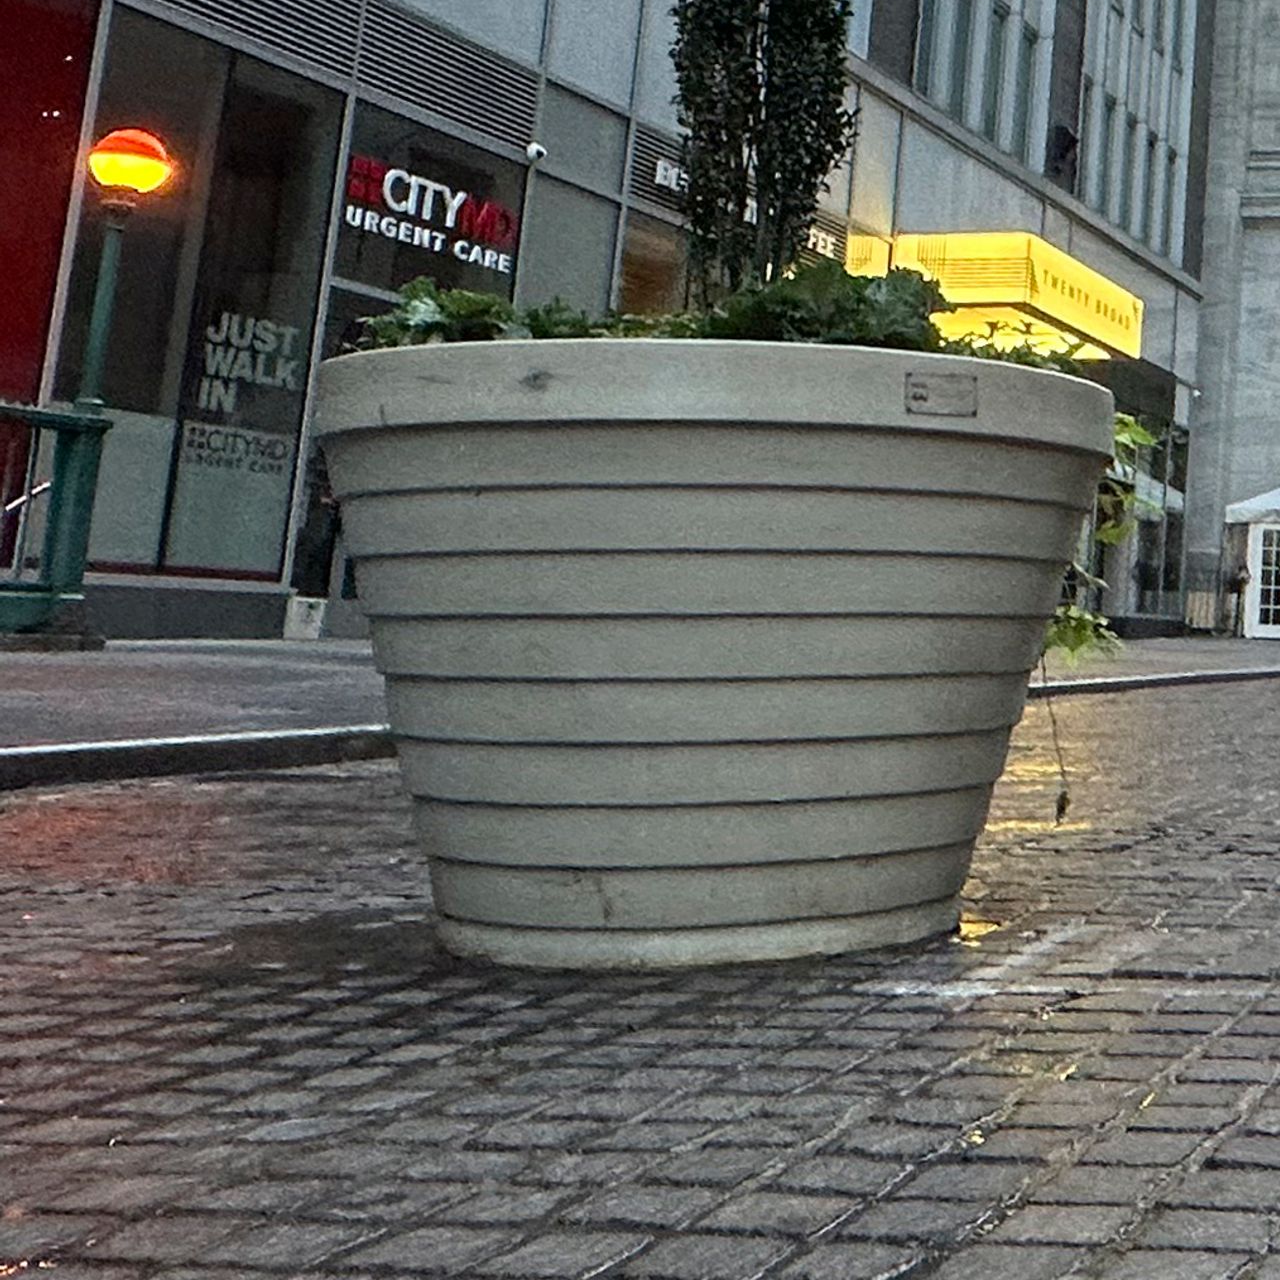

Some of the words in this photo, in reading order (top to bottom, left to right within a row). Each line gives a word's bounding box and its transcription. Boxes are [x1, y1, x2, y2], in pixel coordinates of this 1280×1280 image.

[382, 168, 515, 247] CITYMD
[346, 205, 446, 252] URGENT
[453, 240, 513, 274] CARE
[1042, 269, 1090, 308] TWENTY
[1095, 299, 1131, 331] BROAD
[206, 312, 300, 356] JUST
[198, 377, 238, 413] IN
[205, 342, 301, 392] WALK
